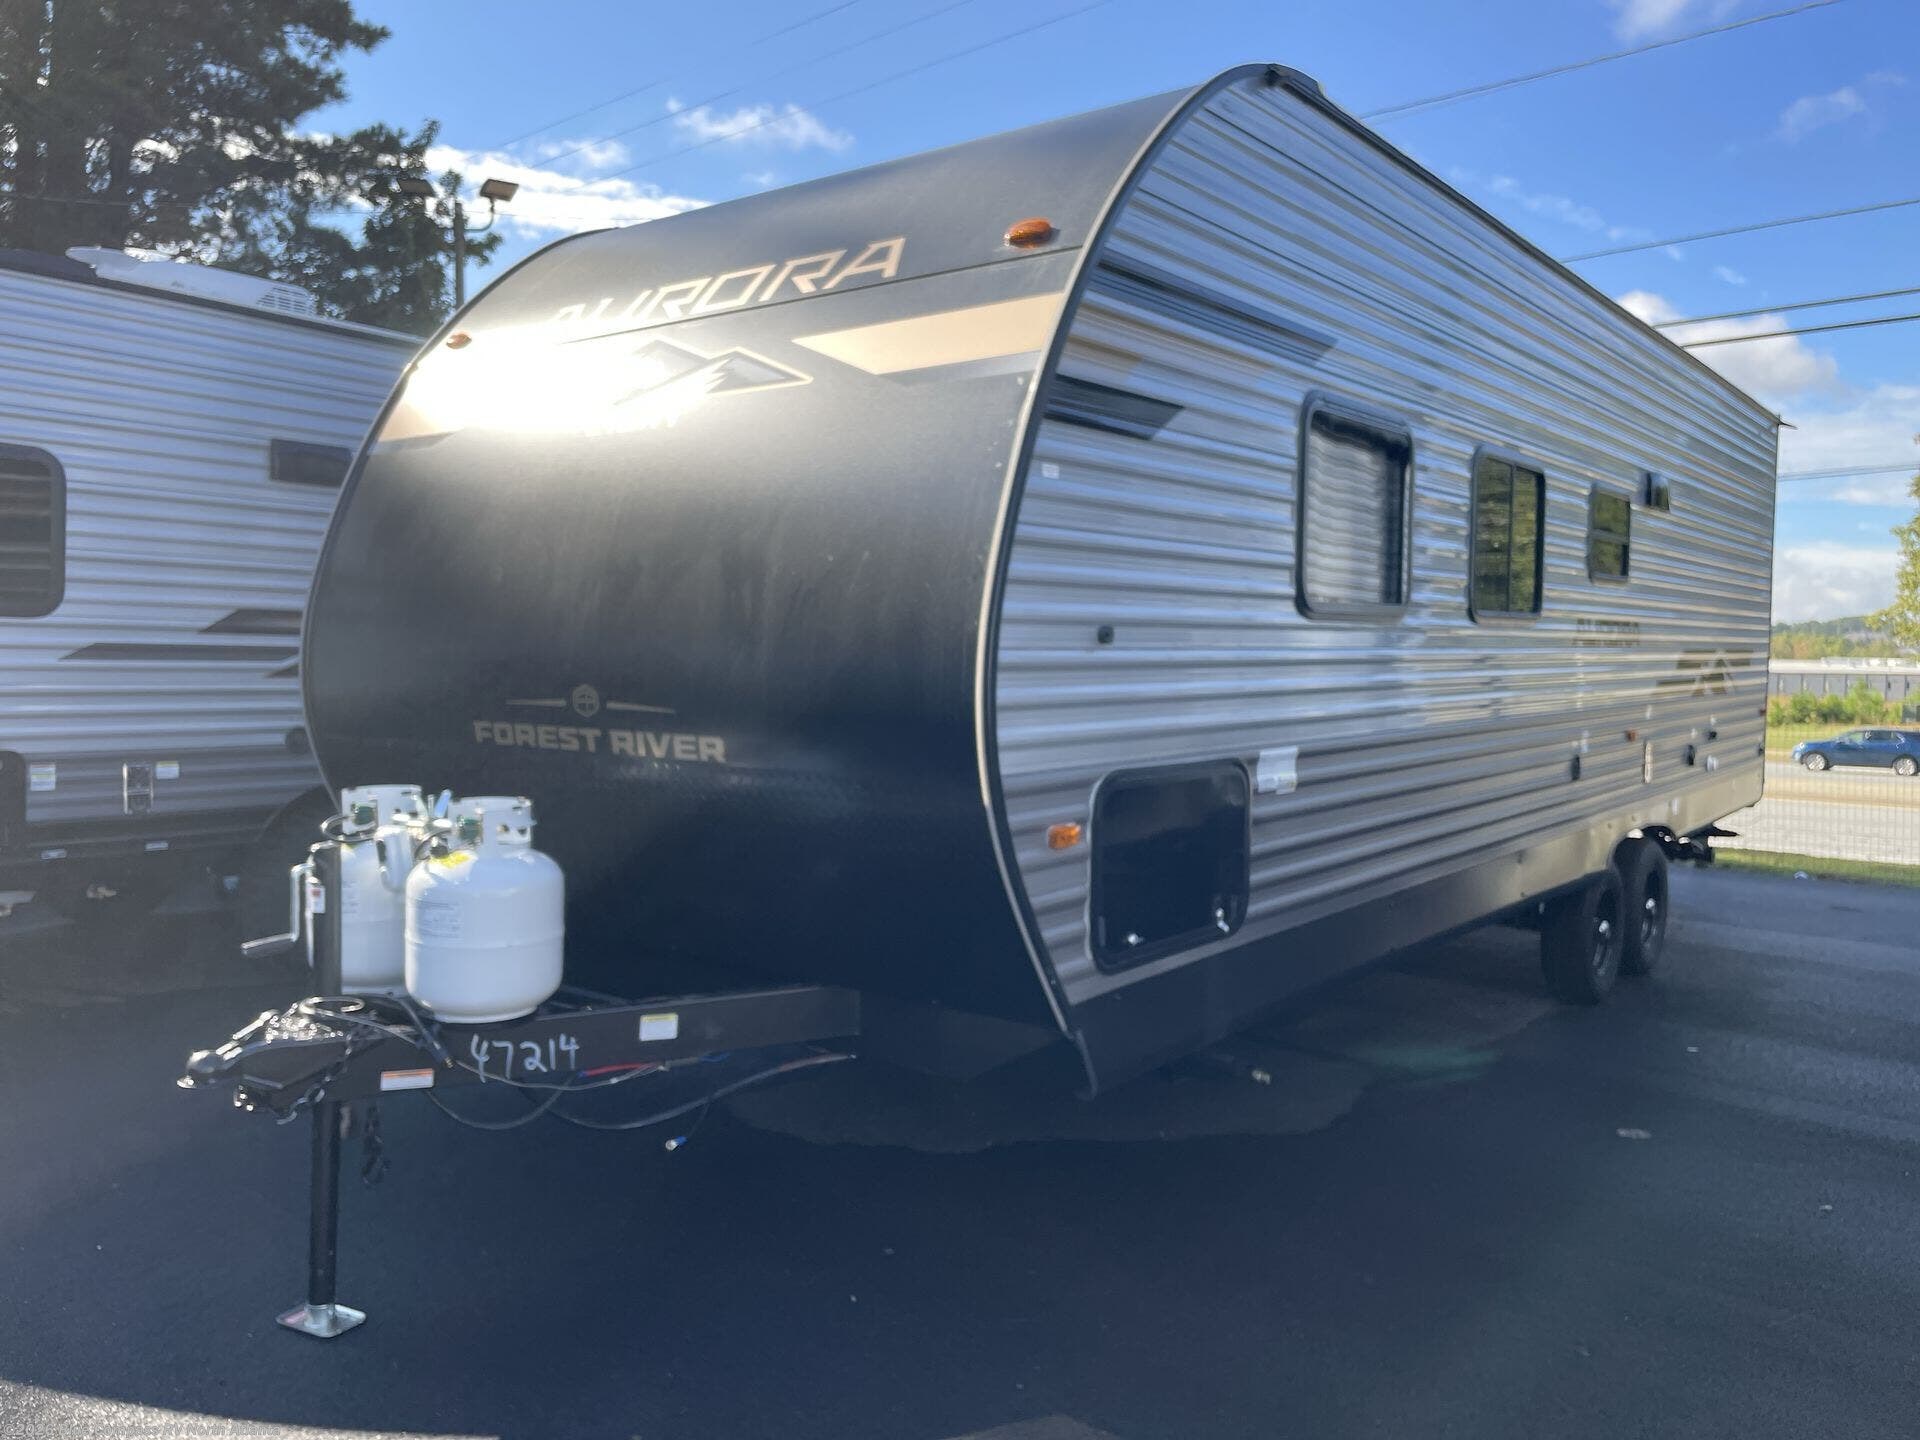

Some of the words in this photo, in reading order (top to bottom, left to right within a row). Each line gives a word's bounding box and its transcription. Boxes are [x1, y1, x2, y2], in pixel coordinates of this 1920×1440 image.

[473, 720, 600, 752] FOREST
[609, 729, 727, 763] RIVER
[470, 1033, 580, 1083] 47214
